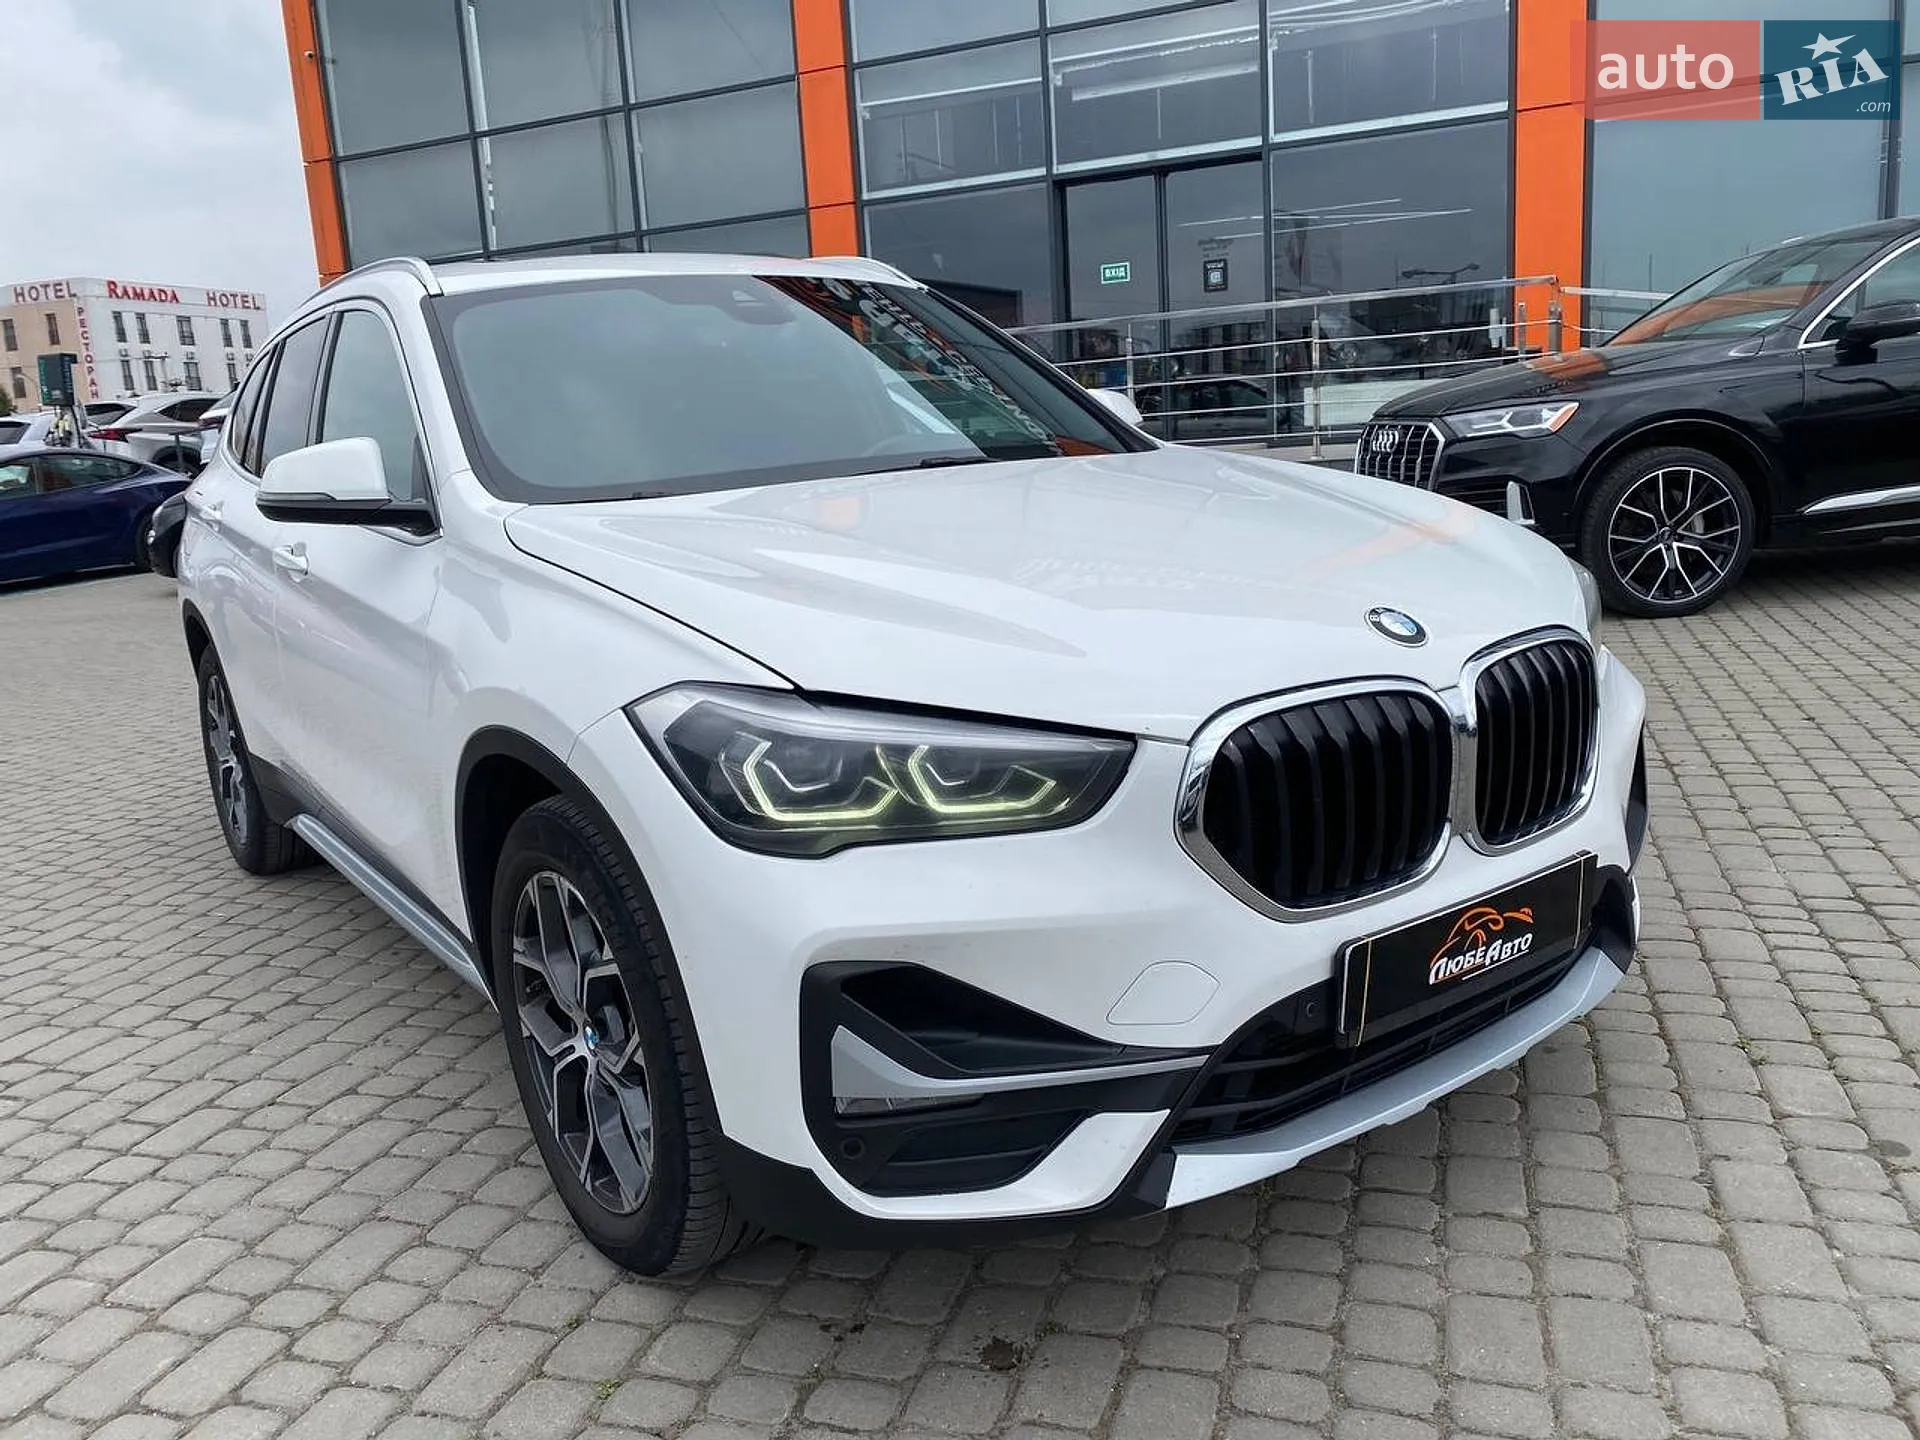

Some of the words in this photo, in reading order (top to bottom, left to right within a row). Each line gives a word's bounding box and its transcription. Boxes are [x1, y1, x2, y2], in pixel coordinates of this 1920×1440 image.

[13, 280, 77, 303] HOTEL
[106, 280, 180, 304] RAMADA
[206, 291, 261, 311] HOTEL
[77, 306, 99, 398] РЕСТОРАН
